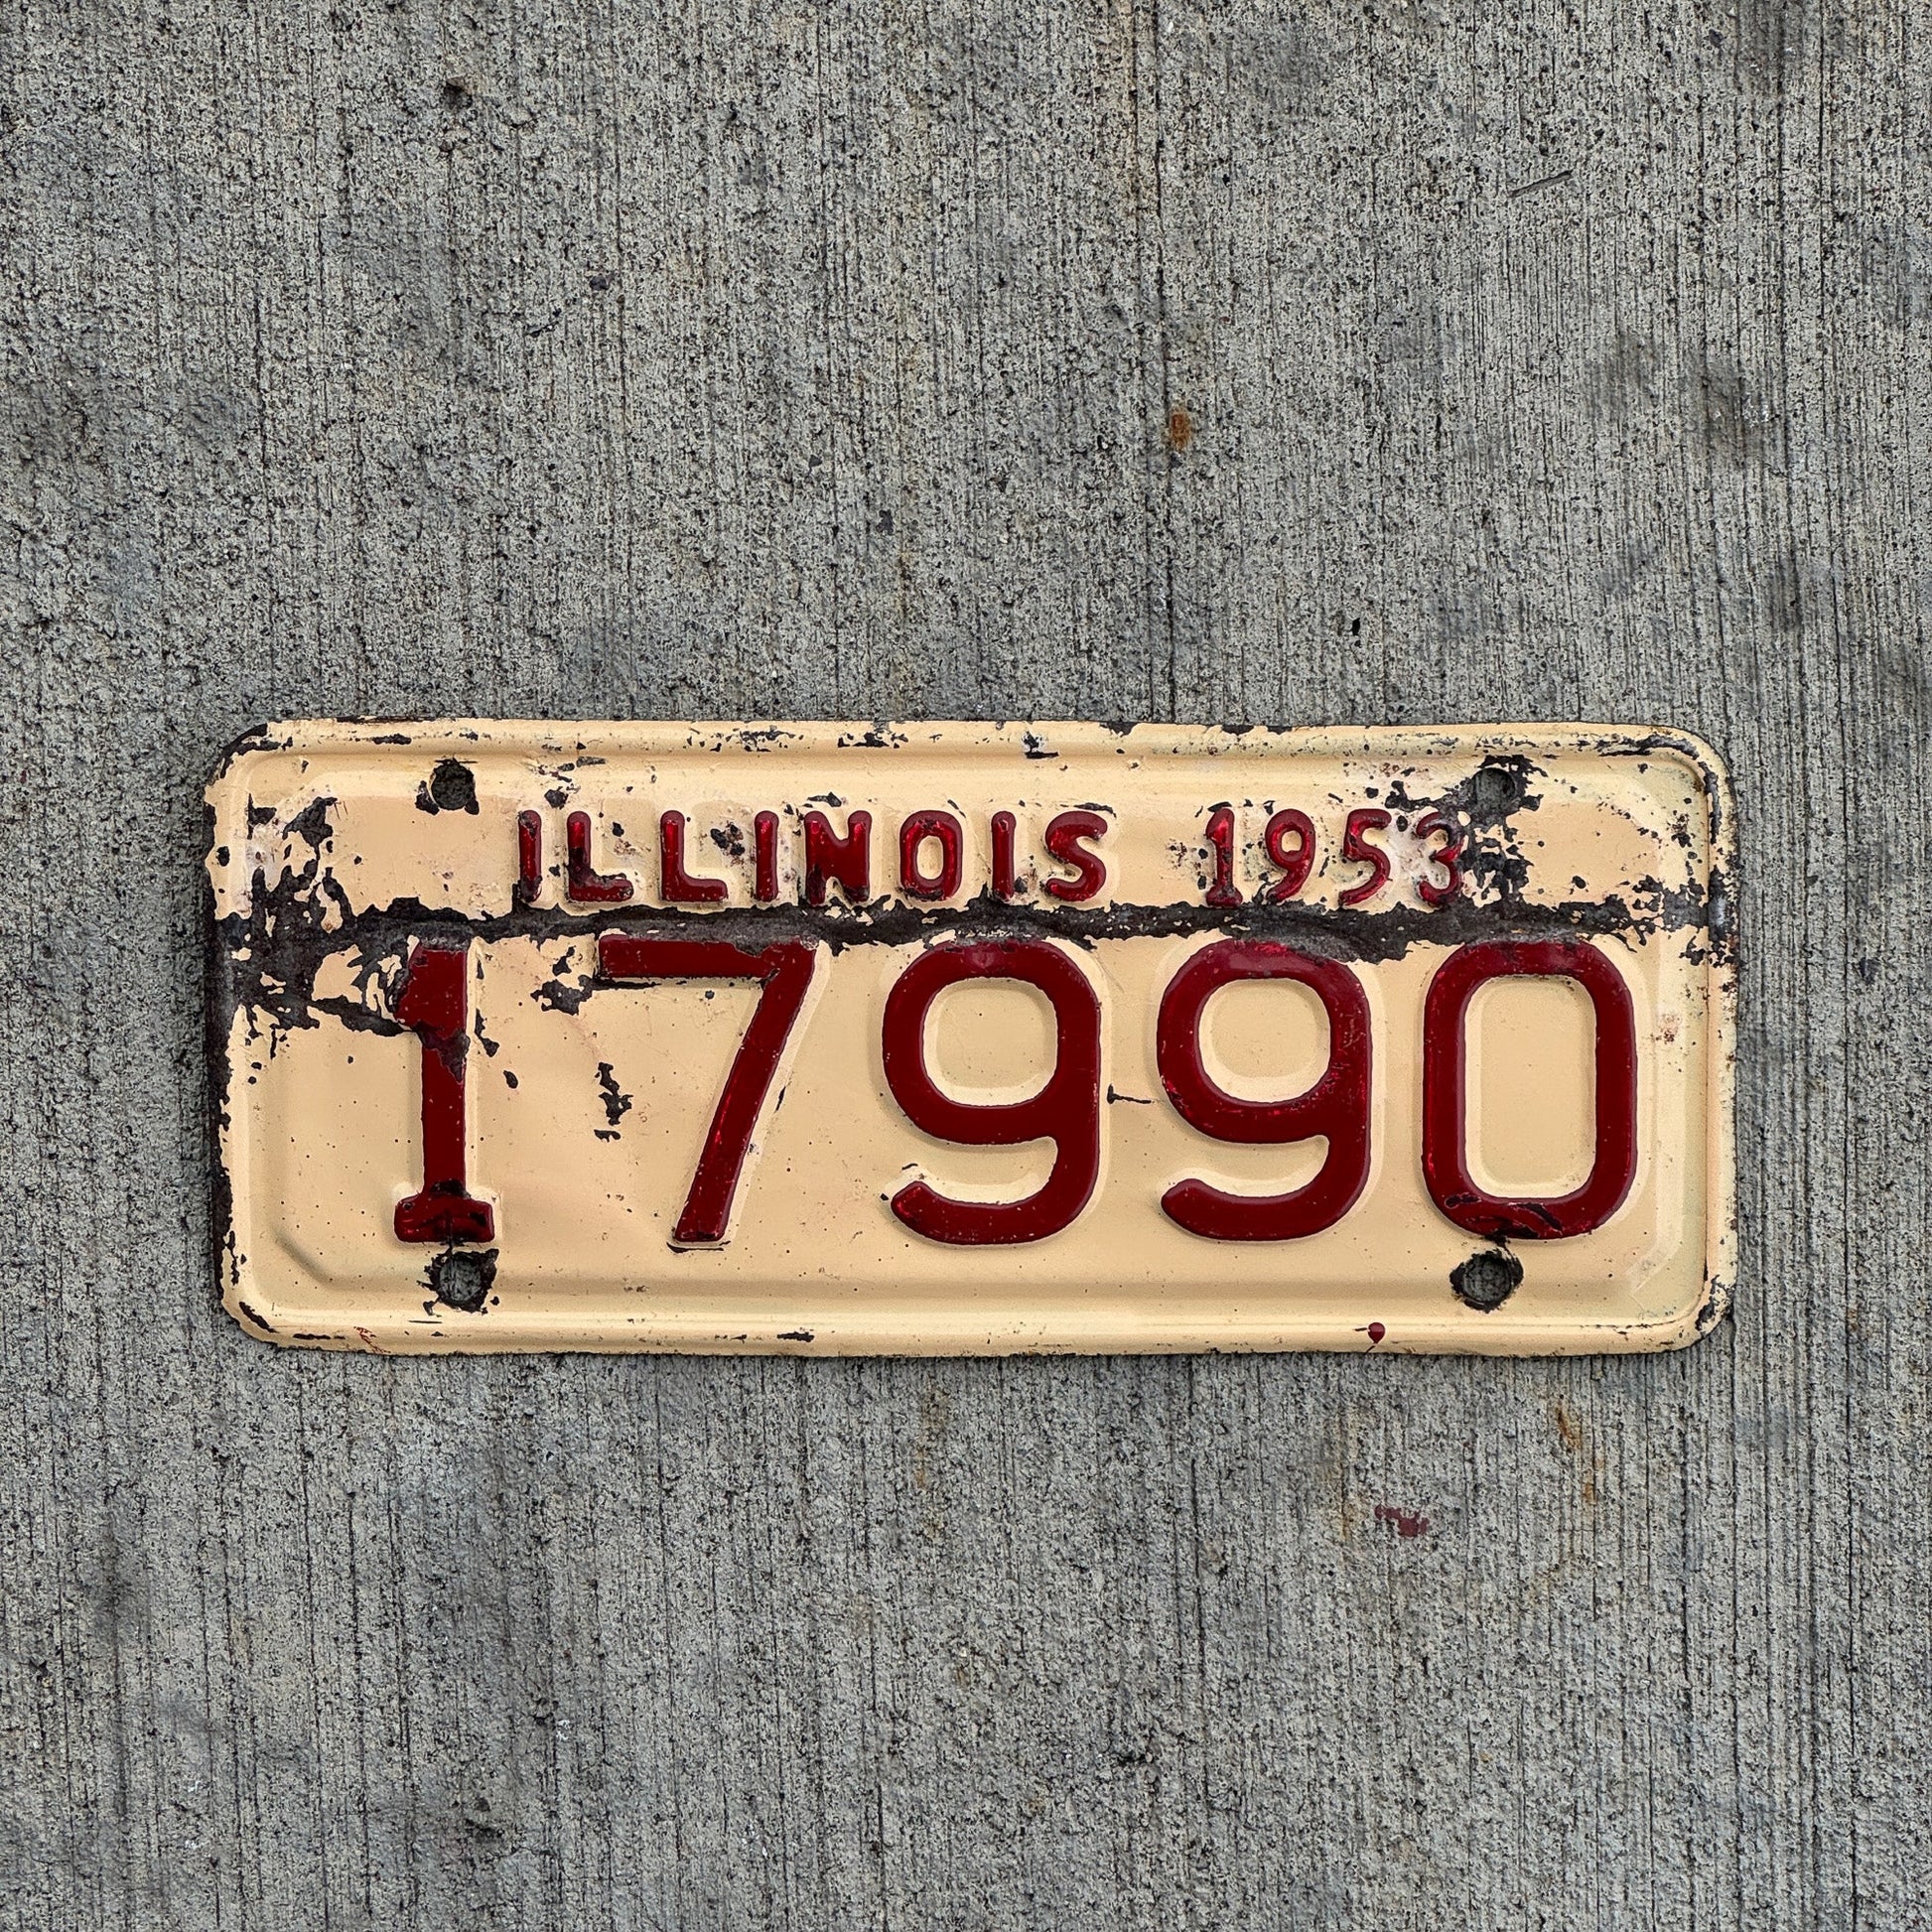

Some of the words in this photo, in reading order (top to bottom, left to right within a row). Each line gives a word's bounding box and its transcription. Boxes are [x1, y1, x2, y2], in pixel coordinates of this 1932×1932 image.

[517, 809, 1109, 904] ILLINOIS
[1204, 807, 1464, 908] 1953
[393, 933, 1638, 1245] 17990
